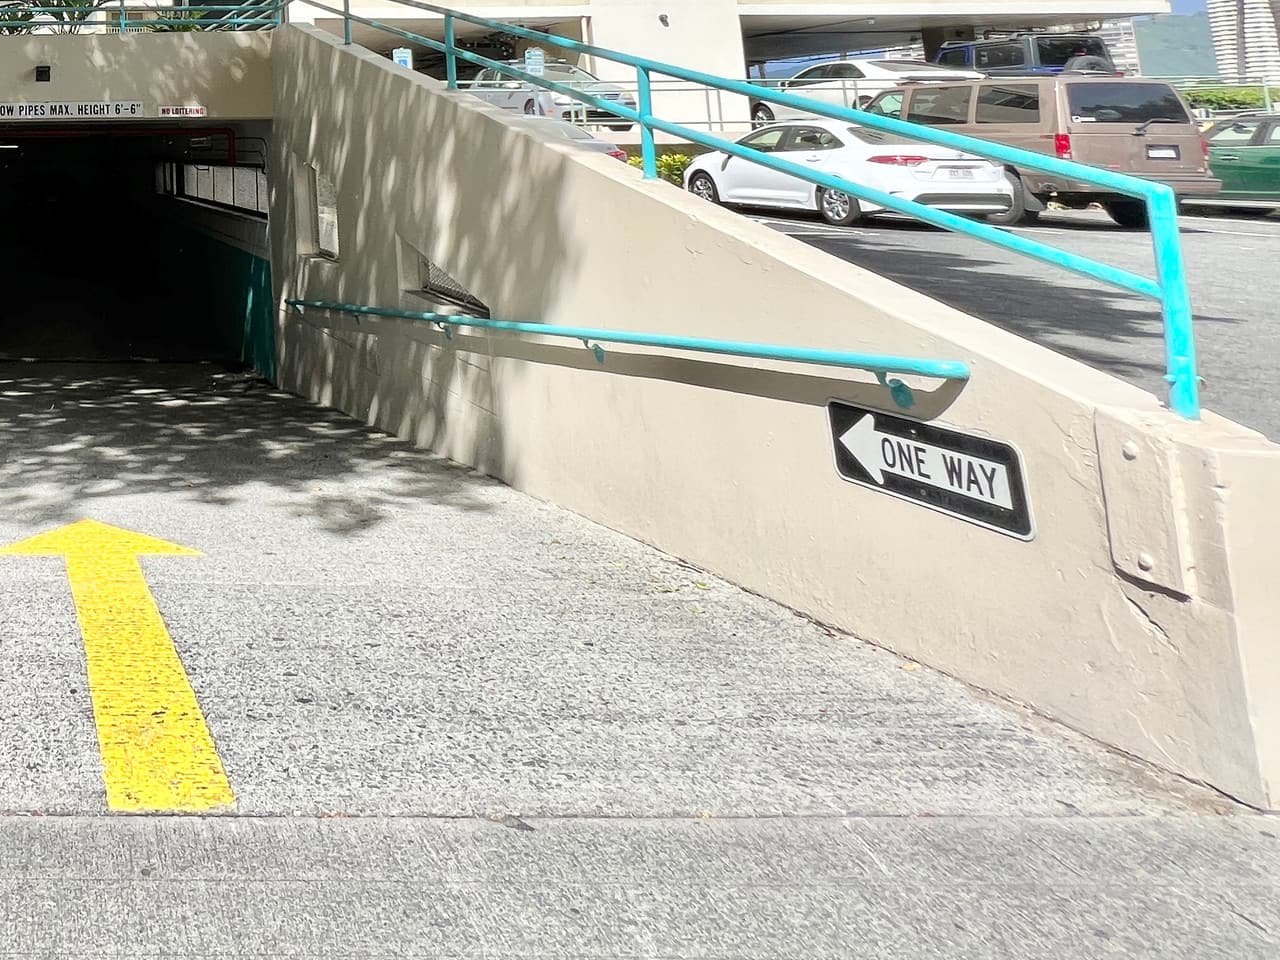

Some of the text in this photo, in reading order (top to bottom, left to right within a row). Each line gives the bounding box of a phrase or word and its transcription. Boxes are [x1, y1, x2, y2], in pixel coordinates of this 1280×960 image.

[18, 104, 46, 116] PIPES
[49, 104, 74, 116] MAX.
[77, 103, 111, 115] HEIGHT
[161, 107, 204, 115] NO LOITERING
[881, 437, 997, 500] ONE WAY
